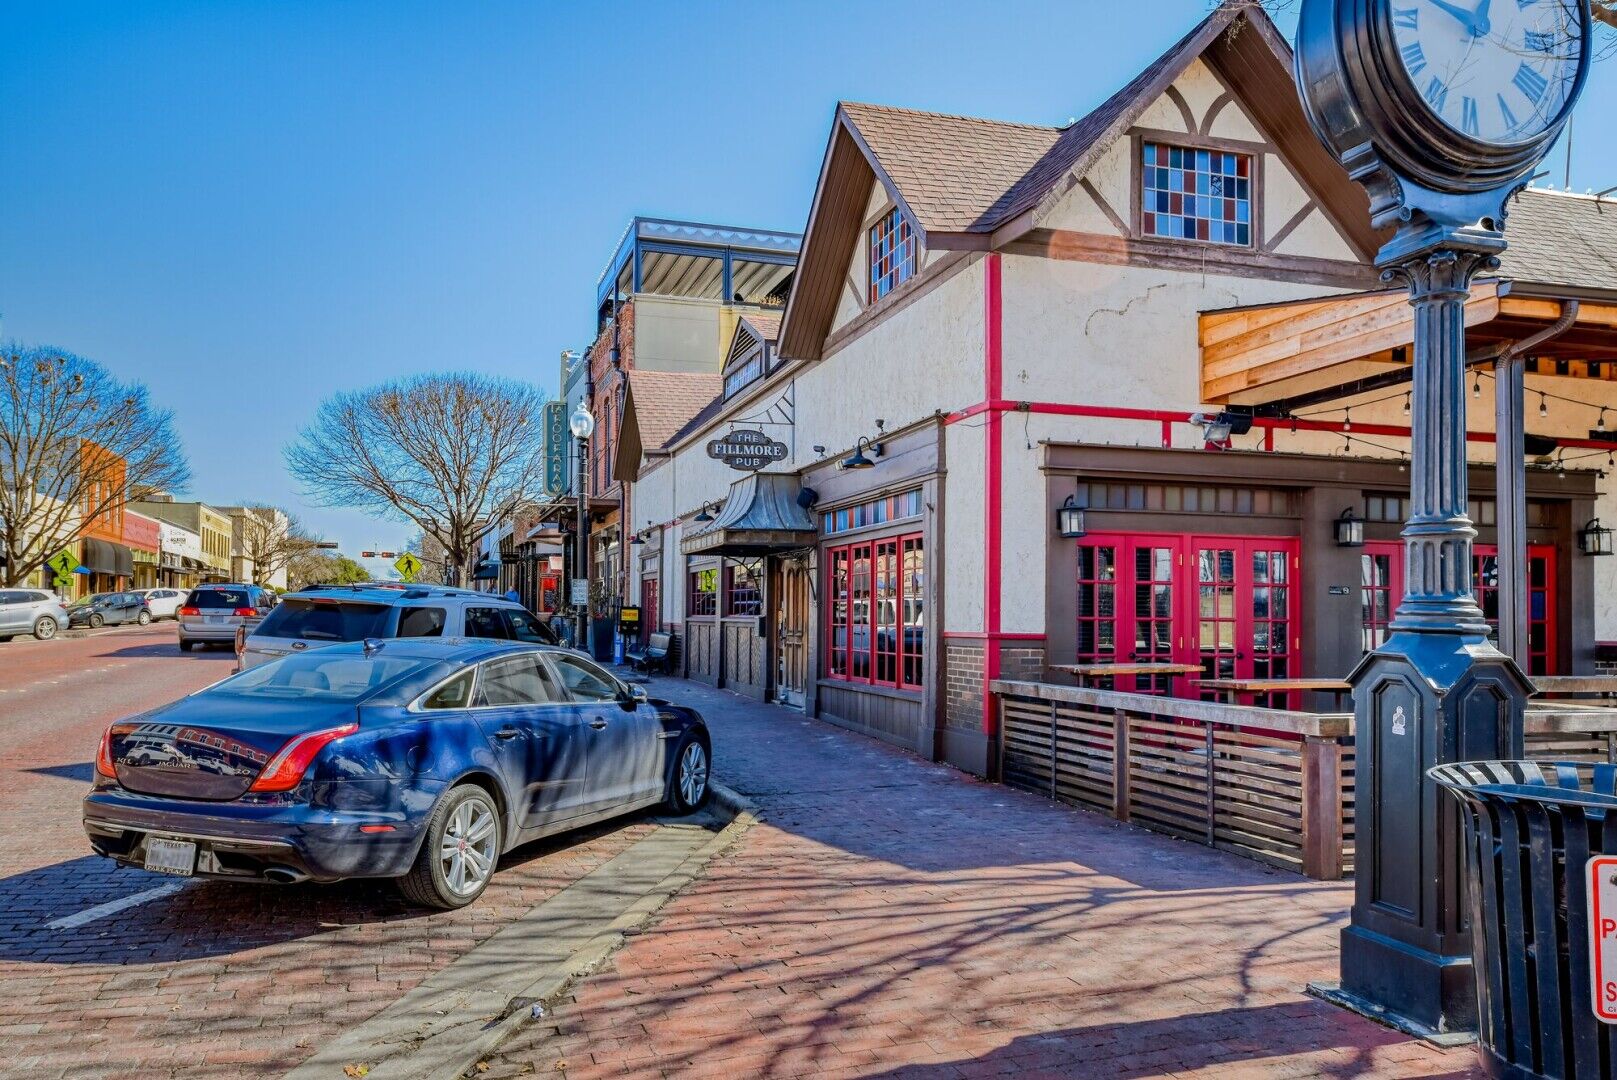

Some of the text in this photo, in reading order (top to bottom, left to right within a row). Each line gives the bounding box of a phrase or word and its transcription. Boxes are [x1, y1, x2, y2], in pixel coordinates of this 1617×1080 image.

[737, 434, 760, 443] THE
[714, 444, 782, 456] FILLMORE
[735, 457, 761, 467] PUB
[157, 761, 192, 769] JAGUAR
